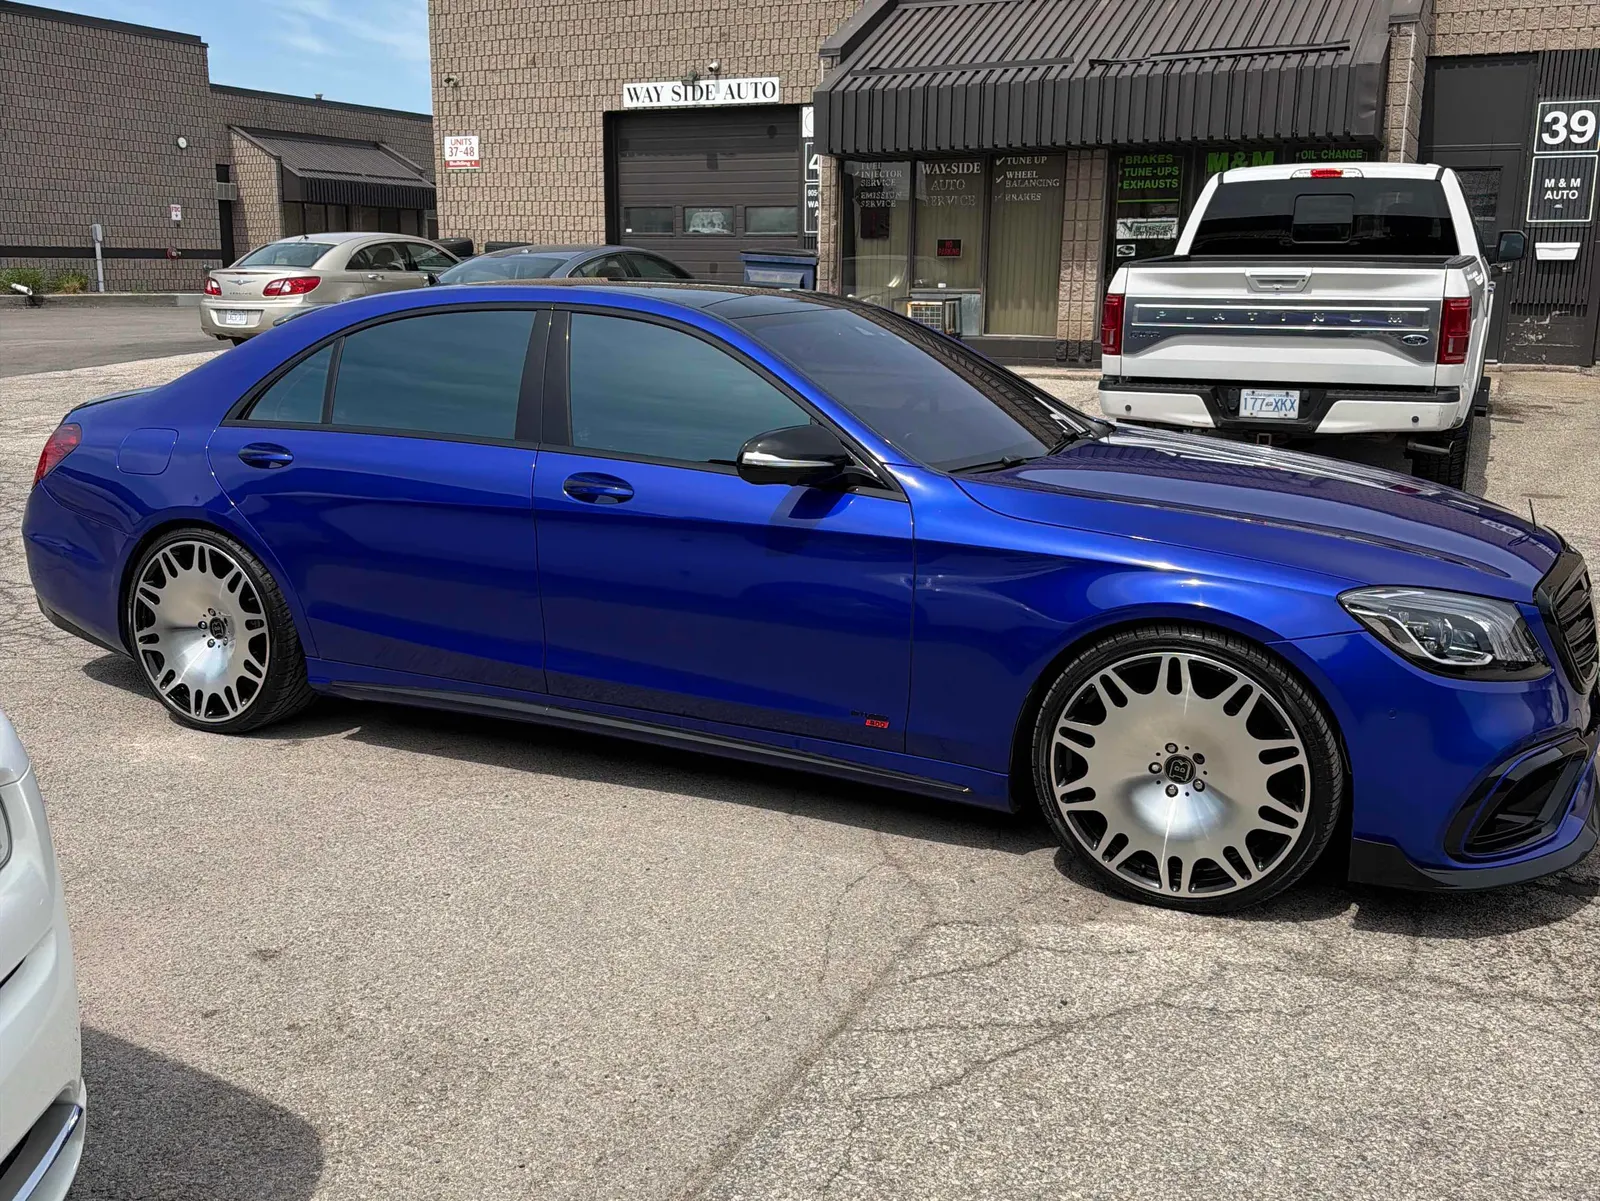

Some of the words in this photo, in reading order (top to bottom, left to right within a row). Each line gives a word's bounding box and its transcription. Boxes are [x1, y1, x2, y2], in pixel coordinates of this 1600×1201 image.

[627, 86, 664, 103] WAY
[671, 84, 716, 102] SIDE
[724, 81, 776, 100] AUTO
[1541, 110, 1596, 145] 39
[450, 138, 473, 146] UNITS
[448, 147, 475, 157] 37-48
[1301, 151, 1317, 160] OIL
[1321, 149, 1363, 159] CHANGE
[1006, 157, 1033, 165] TUNE
[1034, 156, 1047, 164] UP
[1125, 154, 1173, 165] BRAKES
[921, 162, 981, 175] WAY-SIDE
[1124, 166, 1179, 177] TUNE-UPS
[861, 170, 902, 179] INJECTOR
[1006, 170, 1039, 179] WHEEL
[860, 179, 896, 187] SERVICE
[931, 179, 966, 191] AUTO
[1005, 178, 1060, 188] BALANCING
[1123, 178, 1179, 189] EXHAUSTS
[860, 191, 902, 199] EMISSION
[1005, 192, 1042, 201] BRAKES
[1544, 190, 1579, 200] AUTO
[860, 200, 896, 208] SERVICE
[923, 195, 976, 207] SERVICE
